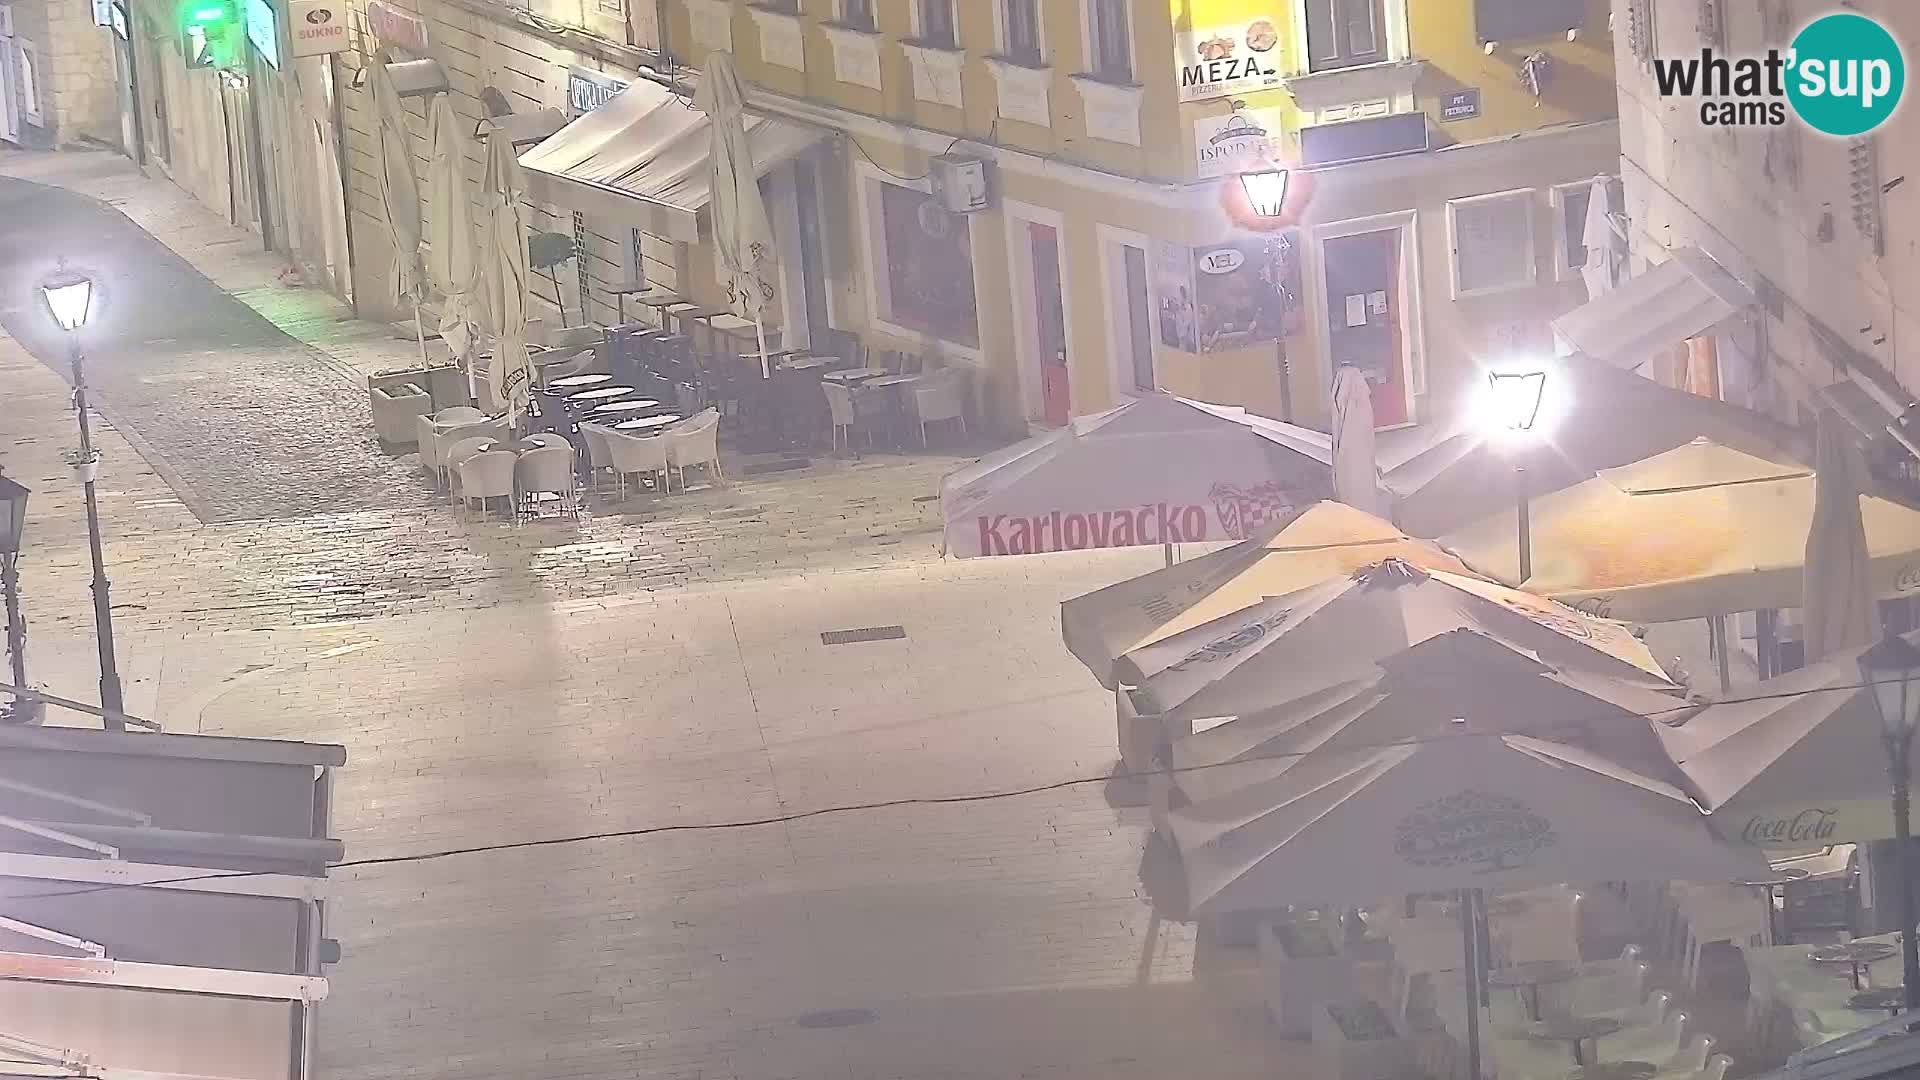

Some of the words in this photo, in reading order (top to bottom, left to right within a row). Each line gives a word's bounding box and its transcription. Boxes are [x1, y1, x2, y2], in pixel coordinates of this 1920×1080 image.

[298, 26, 343, 40] SUKNO
[1182, 57, 1260, 86] MEZA
[978, 503, 1208, 557] Karlovačko
